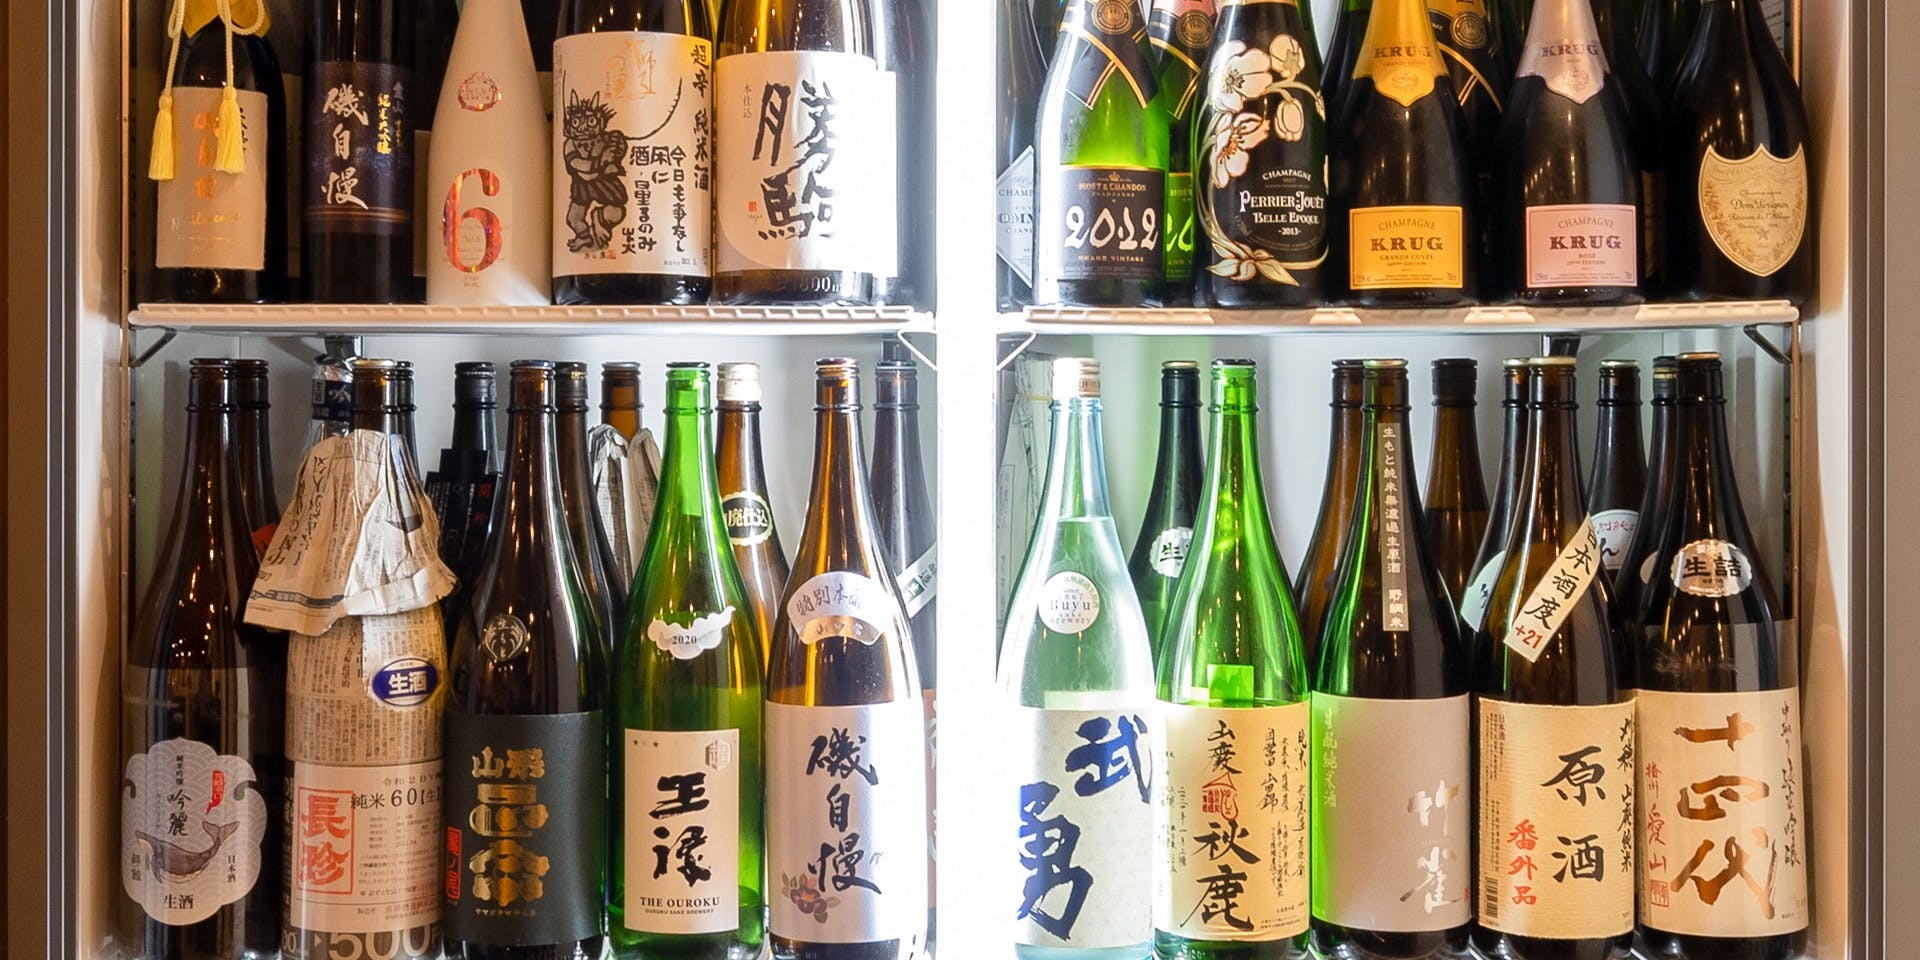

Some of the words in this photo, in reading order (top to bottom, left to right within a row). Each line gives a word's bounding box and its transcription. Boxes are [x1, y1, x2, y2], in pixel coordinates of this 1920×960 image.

[1374, 46, 1432, 58] KRUG
[1542, 44, 1599, 57] KRUG
[690, 45, 710, 98] 超辛
[321, 83, 369, 210] 磯自慢
[693, 108, 710, 191] 純米酒
[1109, 182, 1147, 192] CHANDON
[1262, 169, 1312, 181] CHAMPAGNE
[442, 168, 503, 273] 6
[1064, 205, 1159, 251] 2012
[1252, 212, 1288, 224] BELLE
[1289, 212, 1320, 225] EPOQUE
[1378, 218, 1436, 231] CHAMPAGNE
[1558, 217, 1615, 229] CHAMPAGNE
[1370, 236, 1444, 252] KRUG
[1549, 235, 1622, 250] KRUG
[725, 507, 769, 528] 廃仕込
[1524, 526, 1600, 631] 日本酒度
[1682, 555, 1742, 579] 生詰
[1051, 600, 1090, 612] Buyu
[672, 635, 698, 645] 2020
[1515, 624, 1544, 650] +21
[388, 670, 428, 697] 生酒
[167, 788, 192, 837] 吟麗
[806, 728, 882, 894] 磯自慢
[1541, 745, 1606, 884] 原酒
[1669, 712, 1776, 921] 十四代
[301, 794, 350, 886] 長珍
[227, 855, 237, 884] 日本酒
[1506, 818, 1540, 906] 番外品
[1180, 819, 1262, 932] 秋鹿
[163, 893, 194, 910] 生酒
[640, 896, 663, 907] THE
[666, 896, 720, 908] OUROKU
